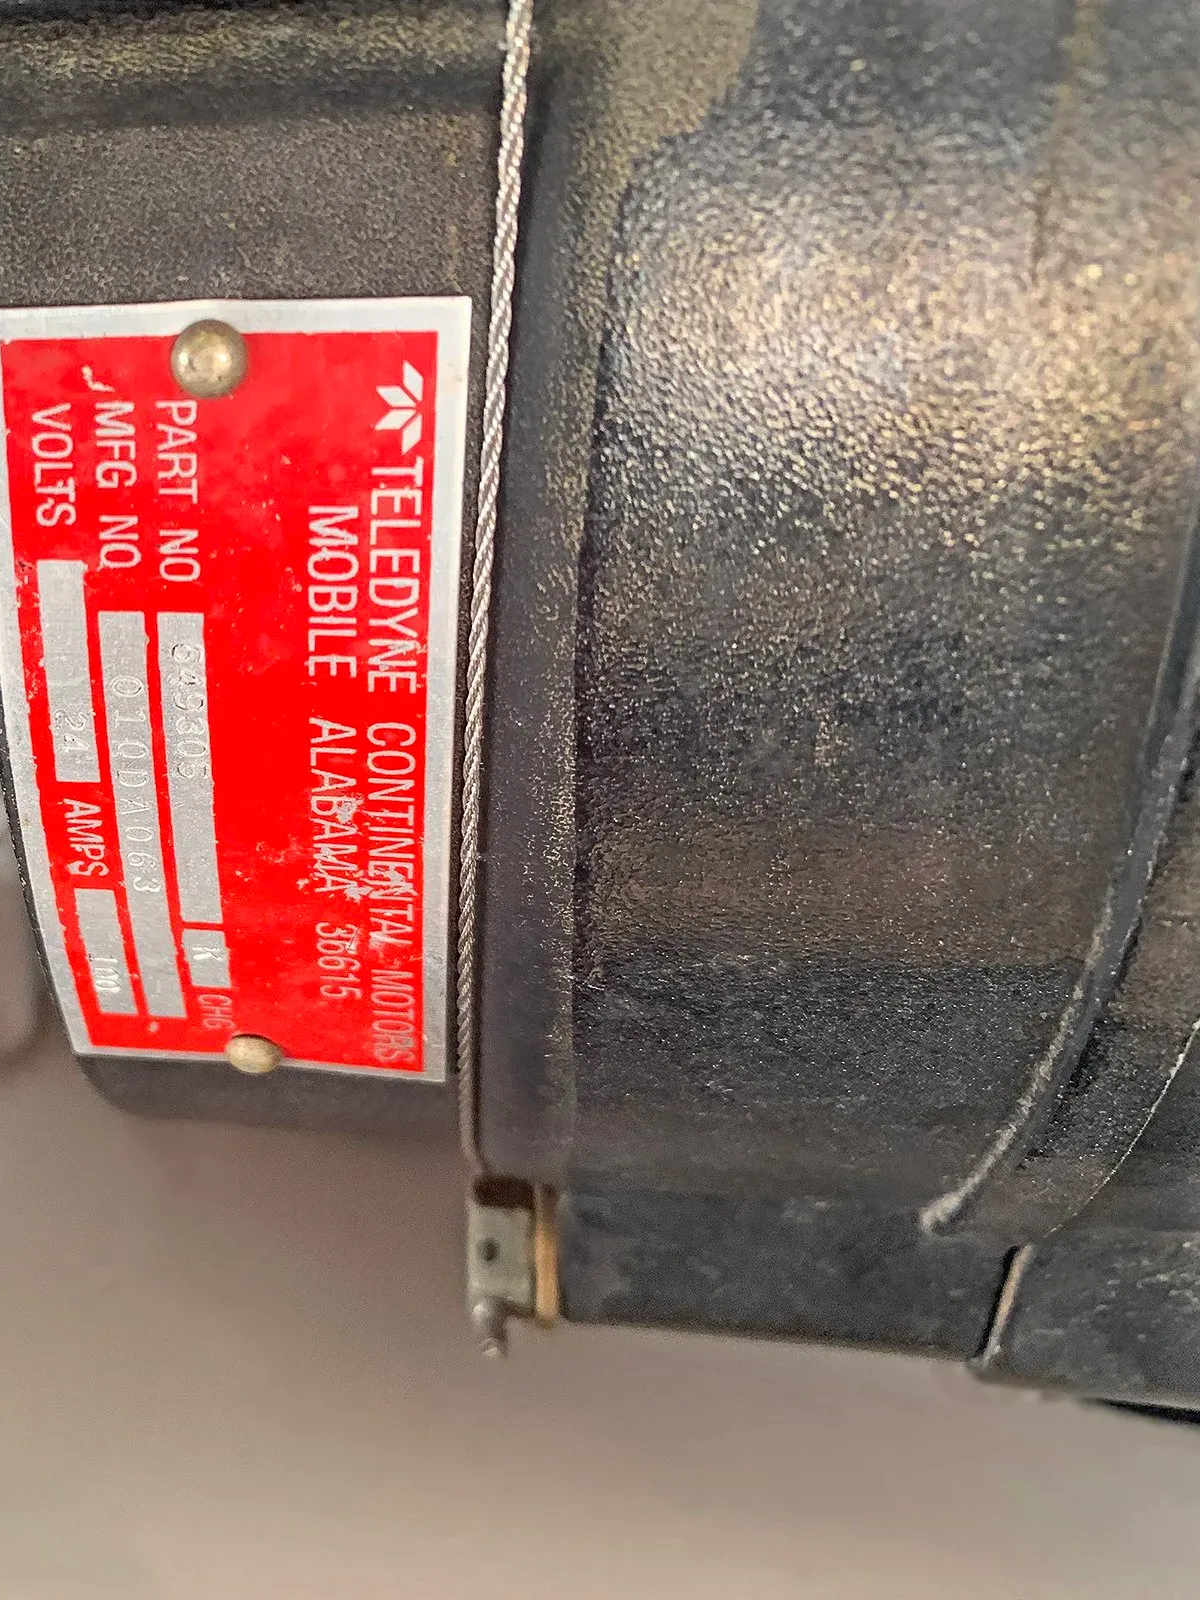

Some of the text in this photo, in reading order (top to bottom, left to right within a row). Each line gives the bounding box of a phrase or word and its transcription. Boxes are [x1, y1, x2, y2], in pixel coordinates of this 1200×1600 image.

[95, 401, 138, 488] MFG
[156, 399, 198, 504] PART
[99, 515, 142, 569] NO
[159, 529, 201, 582] NO
[32, 402, 77, 527] VOLTS
[62, 798, 109, 876] AMPS
[307, 506, 362, 1001] MOBILE ALABAMA 36615
[366, 457, 424, 1063] TELEDYNE CONTINENTAL MOTORS
[198, 993, 237, 1030] CHG
